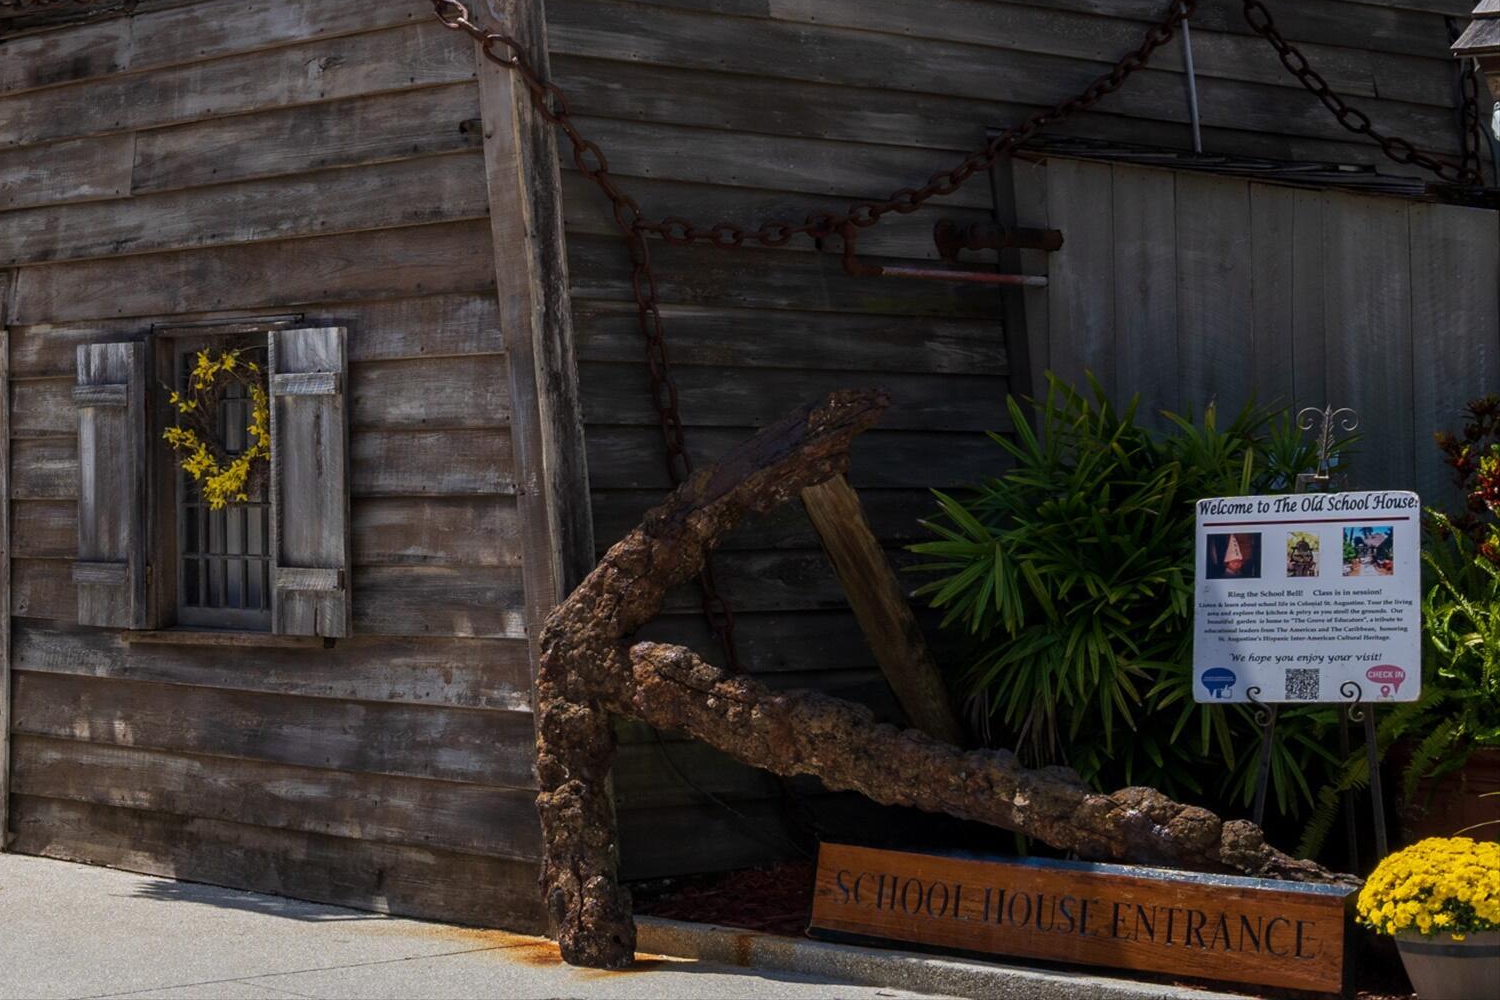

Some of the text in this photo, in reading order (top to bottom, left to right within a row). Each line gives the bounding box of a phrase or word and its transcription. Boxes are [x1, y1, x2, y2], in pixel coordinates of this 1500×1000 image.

[1200, 501, 1253, 516] Welcome
[1257, 500, 1269, 514] to
[1273, 498, 1296, 513] The
[1301, 496, 1323, 512] Old
[1327, 494, 1369, 511] School
[1228, 591, 1245, 599] Ring
[1230, 653, 1382, 665] We hope you enjoy your visit!
[1367, 670, 1405, 679] CHECK IN
[834, 867, 1316, 960] SCHOOL HOUSE ENTRANCE
